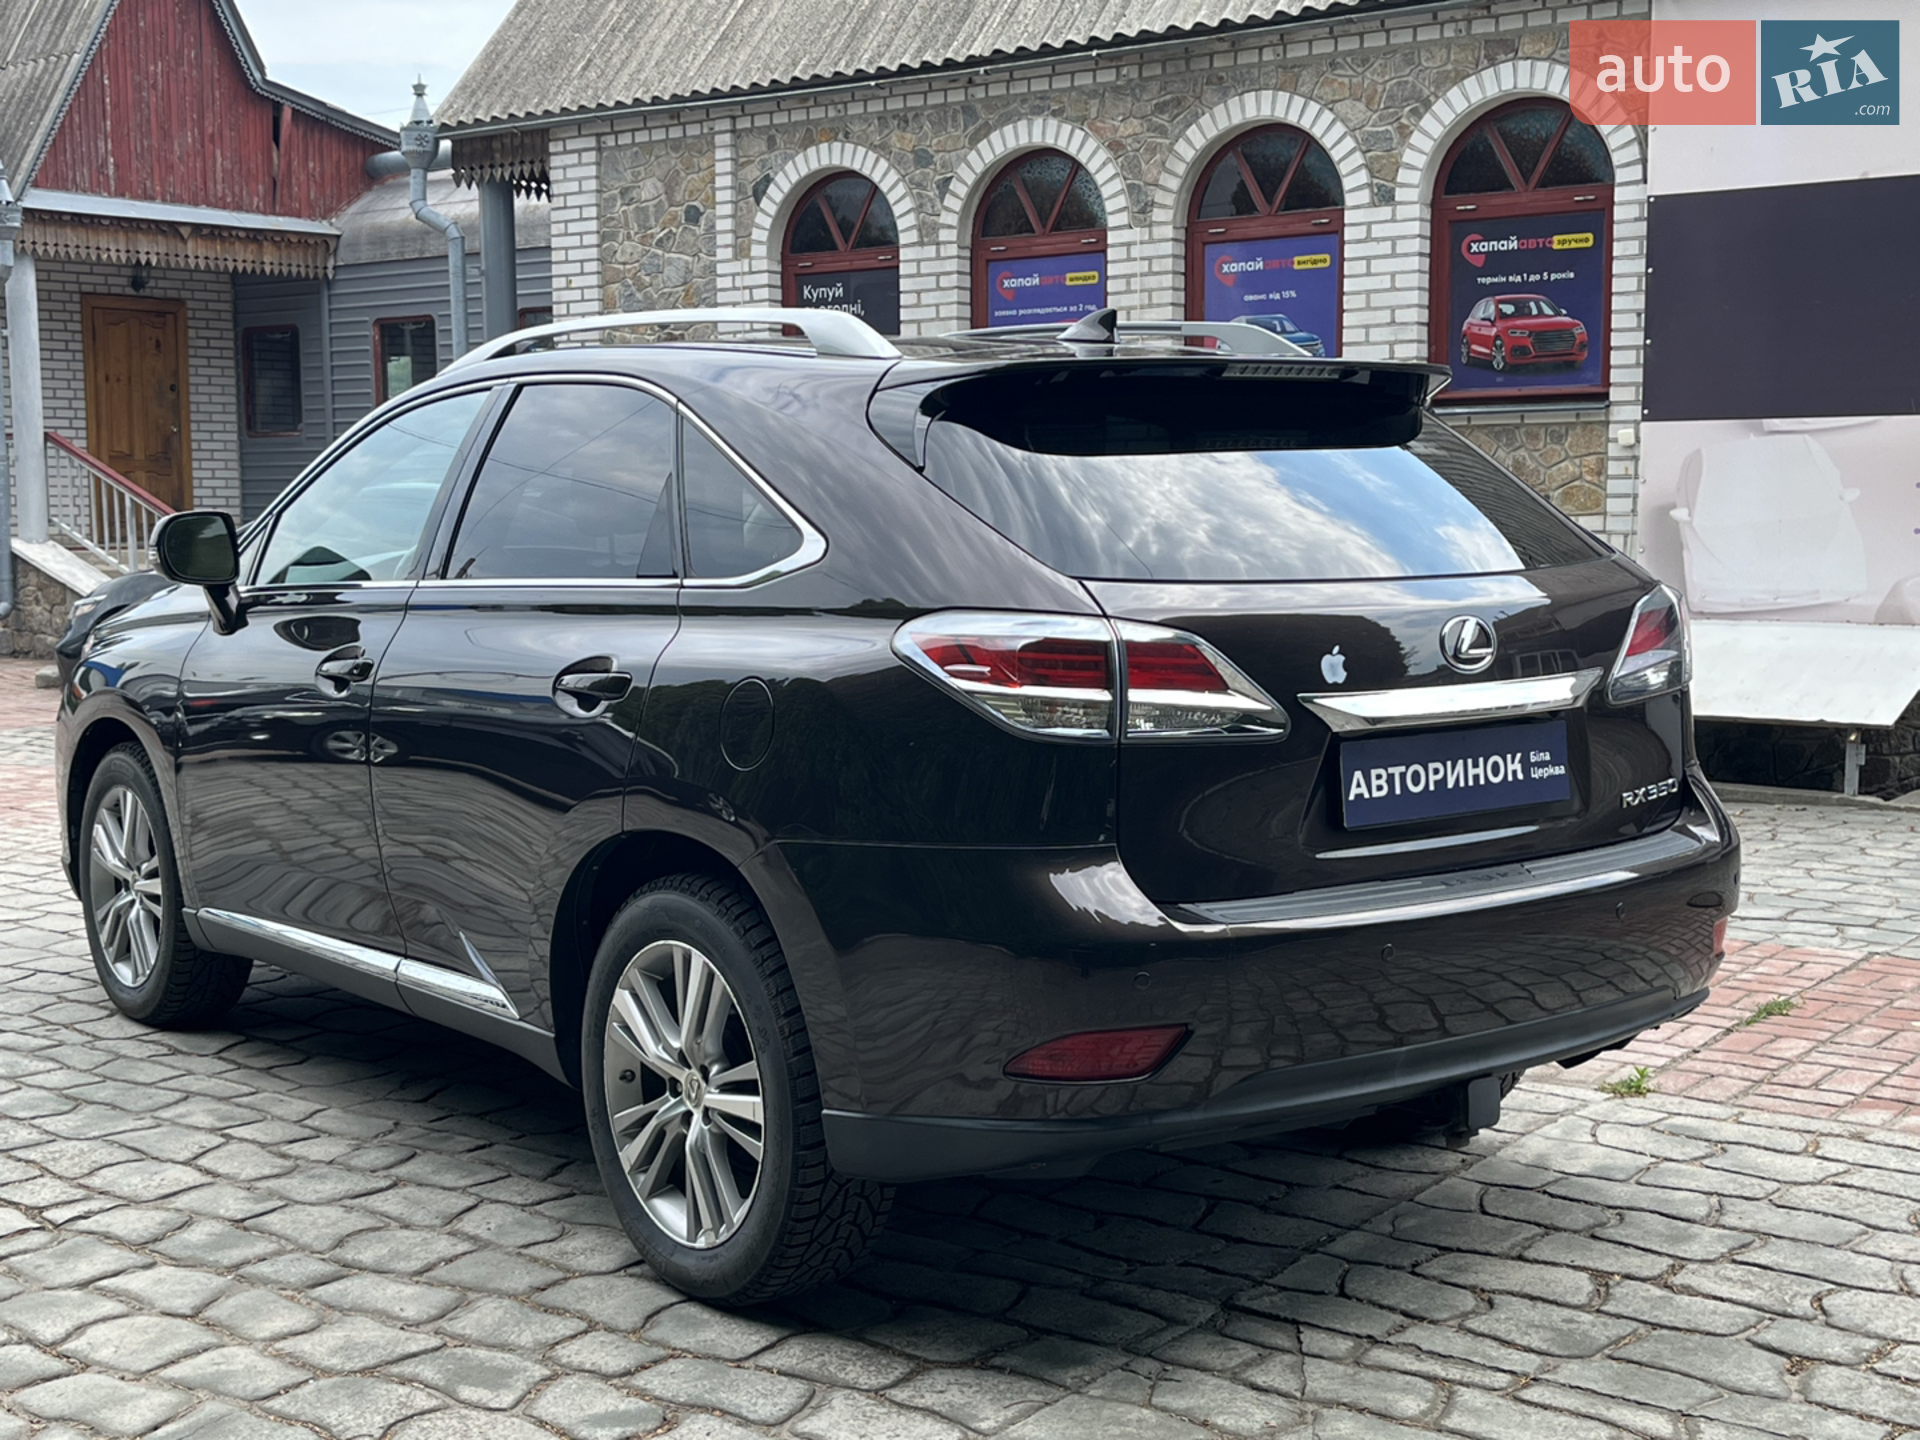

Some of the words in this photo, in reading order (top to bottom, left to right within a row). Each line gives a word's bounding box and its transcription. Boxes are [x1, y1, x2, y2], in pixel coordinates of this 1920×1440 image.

[1556, 237, 1590, 247] зручно
[1476, 274, 1506, 285] термін
[1508, 273, 1522, 283] від
[1522, 273, 1527, 281] 1
[1528, 272, 1540, 283] до
[1542, 271, 1549, 281] 5
[1550, 270, 1575, 282] років
[803, 283, 844, 303] Купуй
[1268, 291, 1280, 301] від
[1281, 290, 1297, 299] 15%
[1348, 752, 1524, 801] АВТОРИНОК
[1530, 751, 1550, 762] Біла
[1530, 763, 1566, 779] Церква
